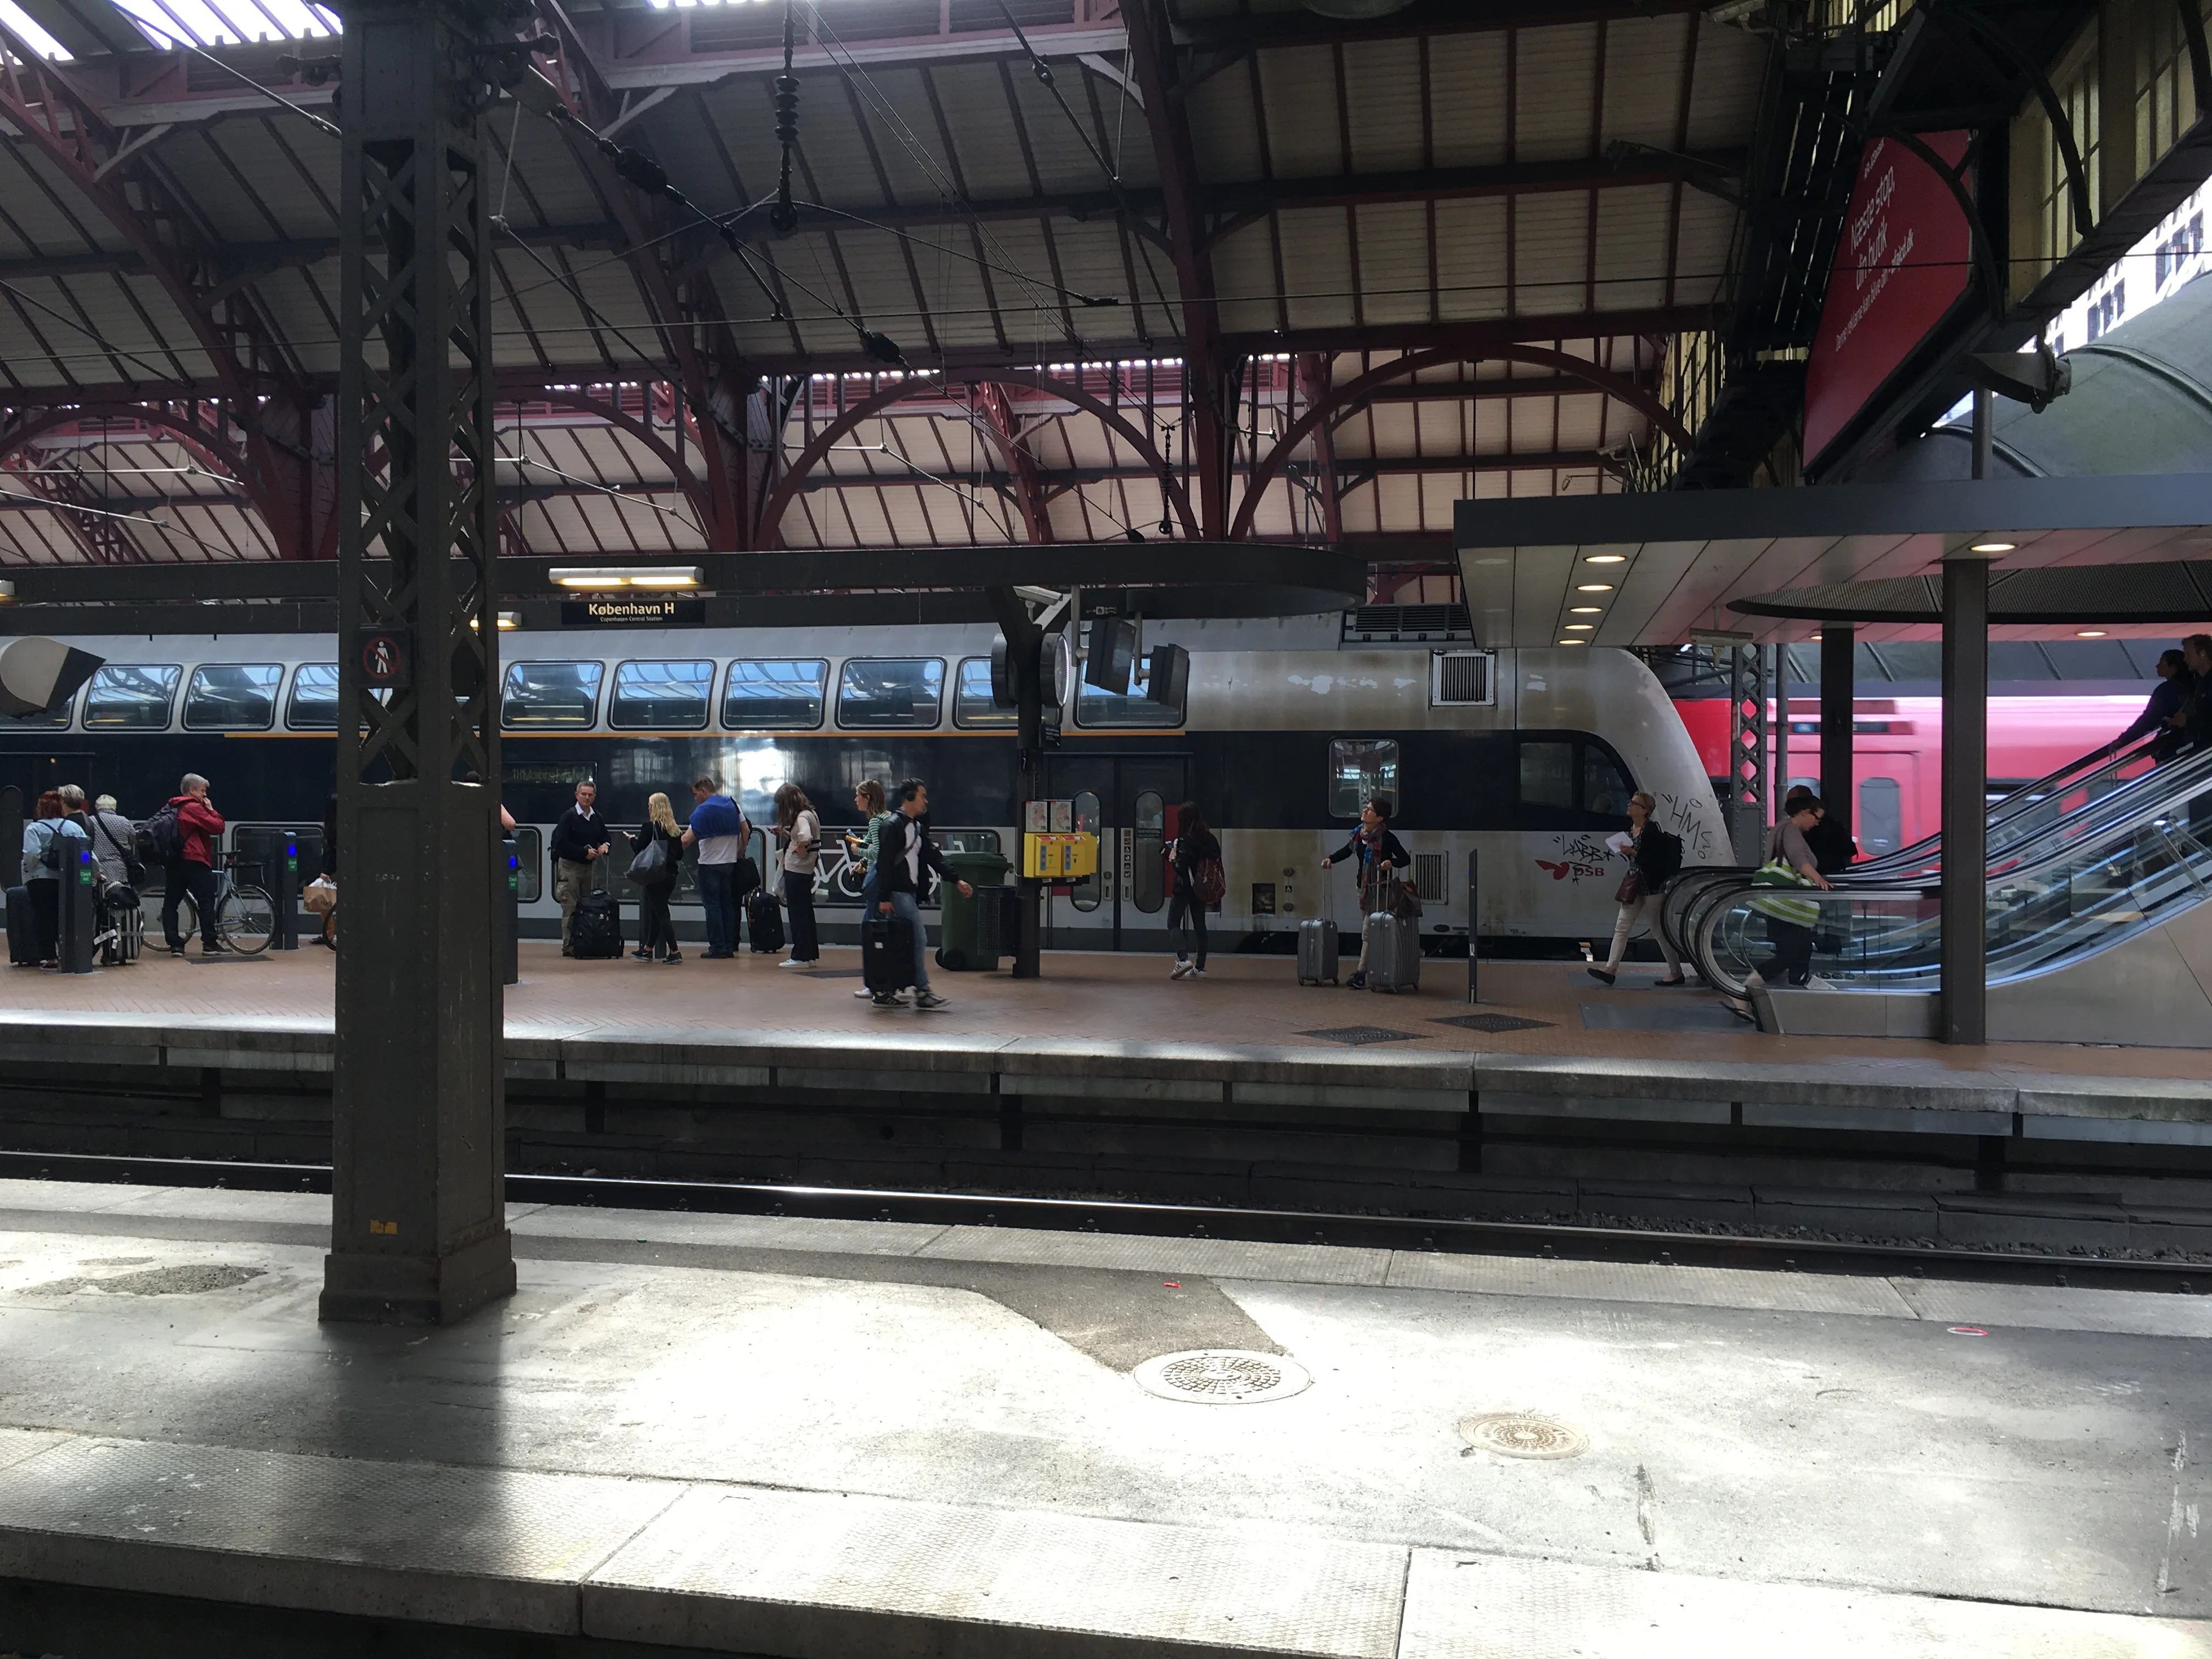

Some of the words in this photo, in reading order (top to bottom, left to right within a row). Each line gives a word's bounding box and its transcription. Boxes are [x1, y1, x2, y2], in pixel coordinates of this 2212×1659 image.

[1850, 198, 1875, 256] Næste
[1857, 253, 1867, 291] din
[1868, 215, 1887, 274] butik
[589, 602, 661, 616] København
[664, 602, 675, 614] H
[1573, 867, 1605, 876] DSB
